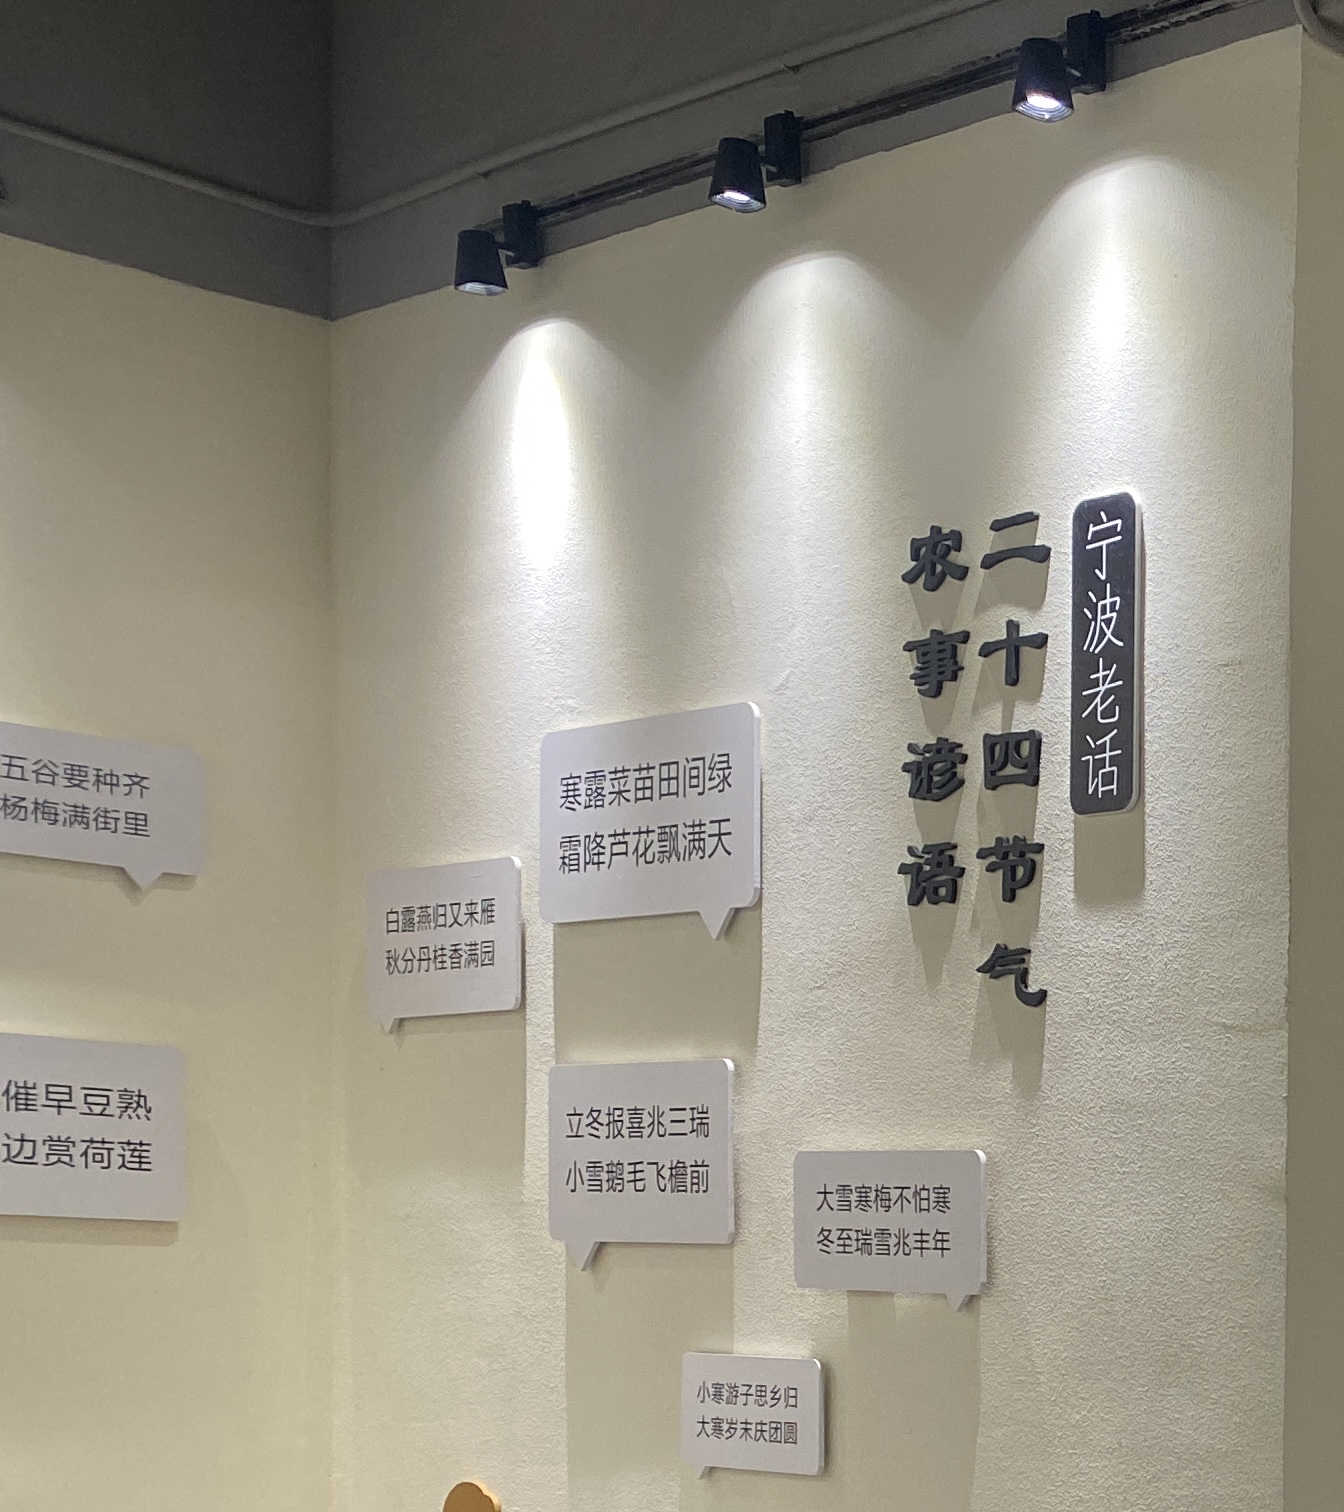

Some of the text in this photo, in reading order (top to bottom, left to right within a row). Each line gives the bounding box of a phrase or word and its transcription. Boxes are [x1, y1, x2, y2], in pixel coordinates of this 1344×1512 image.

[1081, 511, 1124, 798] 宁波老话
[898, 525, 970, 906] 农事谚语
[0, 754, 151, 798] 五谷要种齐
[976, 511, 1051, 1007] 二十四节气
[559, 753, 733, 812] 寒露菜苗田间绿
[0, 793, 151, 838] 杨梅满街里
[559, 818, 733, 874] 霜降芦花飘满天
[385, 898, 496, 935] 白露燕归又来雁
[385, 940, 495, 975] 秋分丹桂香满园
[1, 1079, 152, 1121] 催早豆熟
[565, 1104, 710, 1139] 立冬报喜兆三瑞
[1, 1132, 152, 1171] 边赏荷莲
[565, 1158, 710, 1194] 小雪鹅毛飞檐前
[816, 1183, 951, 1214] 大雪寒梅不怕寒
[816, 1226, 951, 1258] 冬至瑞雪兆丰年
[696, 1380, 799, 1409] 小寒游子思乡归
[696, 1415, 798, 1445] 大寒岁末庆团圆
